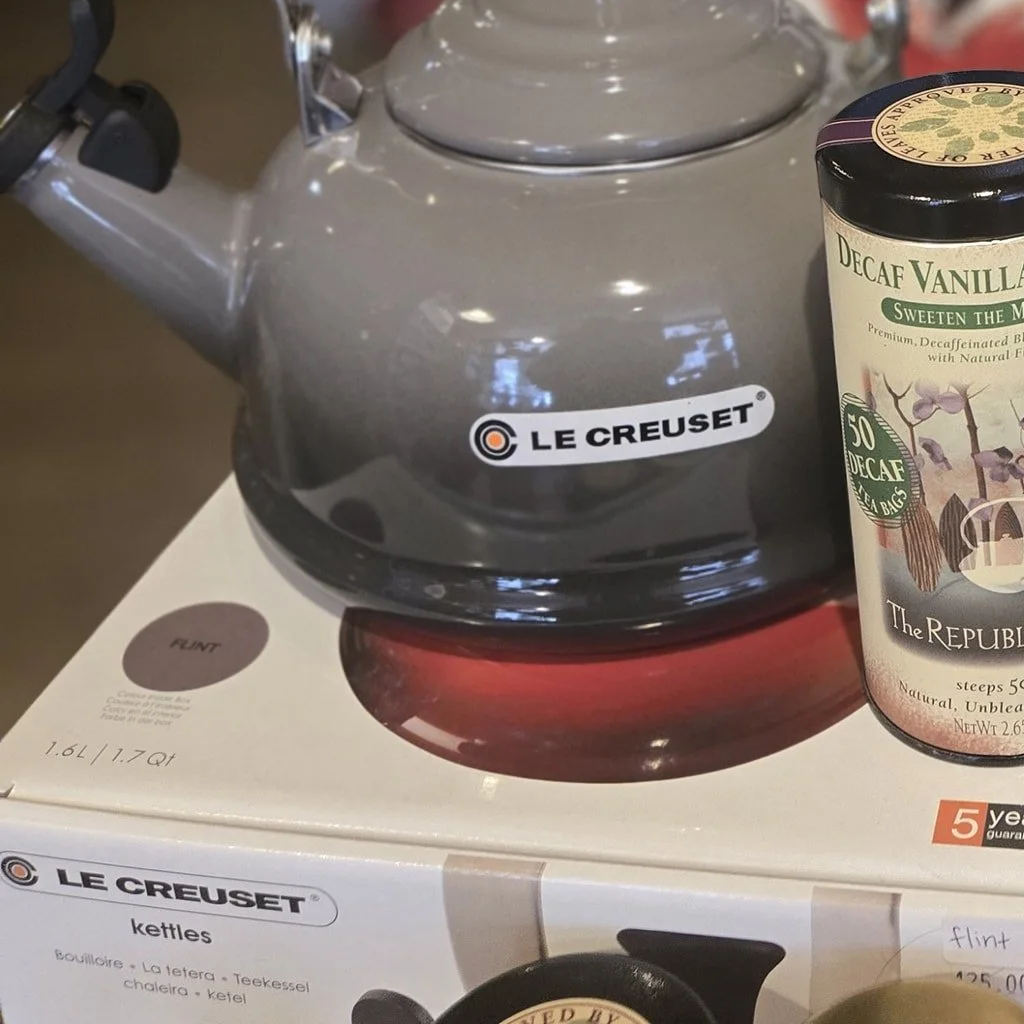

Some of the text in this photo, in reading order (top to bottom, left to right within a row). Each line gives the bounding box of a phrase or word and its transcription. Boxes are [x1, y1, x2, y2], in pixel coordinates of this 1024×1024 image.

[886, 86, 989, 121] APPROVED
[881, 125, 928, 159] LEAVES
[936, 154, 967, 162] OF
[836, 232, 904, 290] DECAF
[893, 302, 966, 326] SWEETEN
[973, 309, 1004, 324] THE
[920, 335, 1009, 350] Decaffeinated
[928, 351, 955, 363] with
[960, 349, 1010, 364] Natural
[531, 403, 754, 451] LE CREUSET
[847, 412, 875, 451] 50
[848, 450, 905, 482] DECAF
[858, 481, 907, 516] TEA BAGS
[886, 599, 924, 640] The
[169, 637, 222, 654] FLINT
[899, 679, 958, 712] Natural,
[956, 679, 1004, 697] steeps
[45, 741, 88, 759] 1.6L
[951, 808, 980, 839] 5
[56, 868, 306, 914] LE CREUSET
[131, 918, 212, 945] kettles
[950, 926, 1011, 950] flint
[54, 948, 310, 994] Bouilloire La tetera Teekessel
[123, 978, 247, 1005] chaleira ketel
